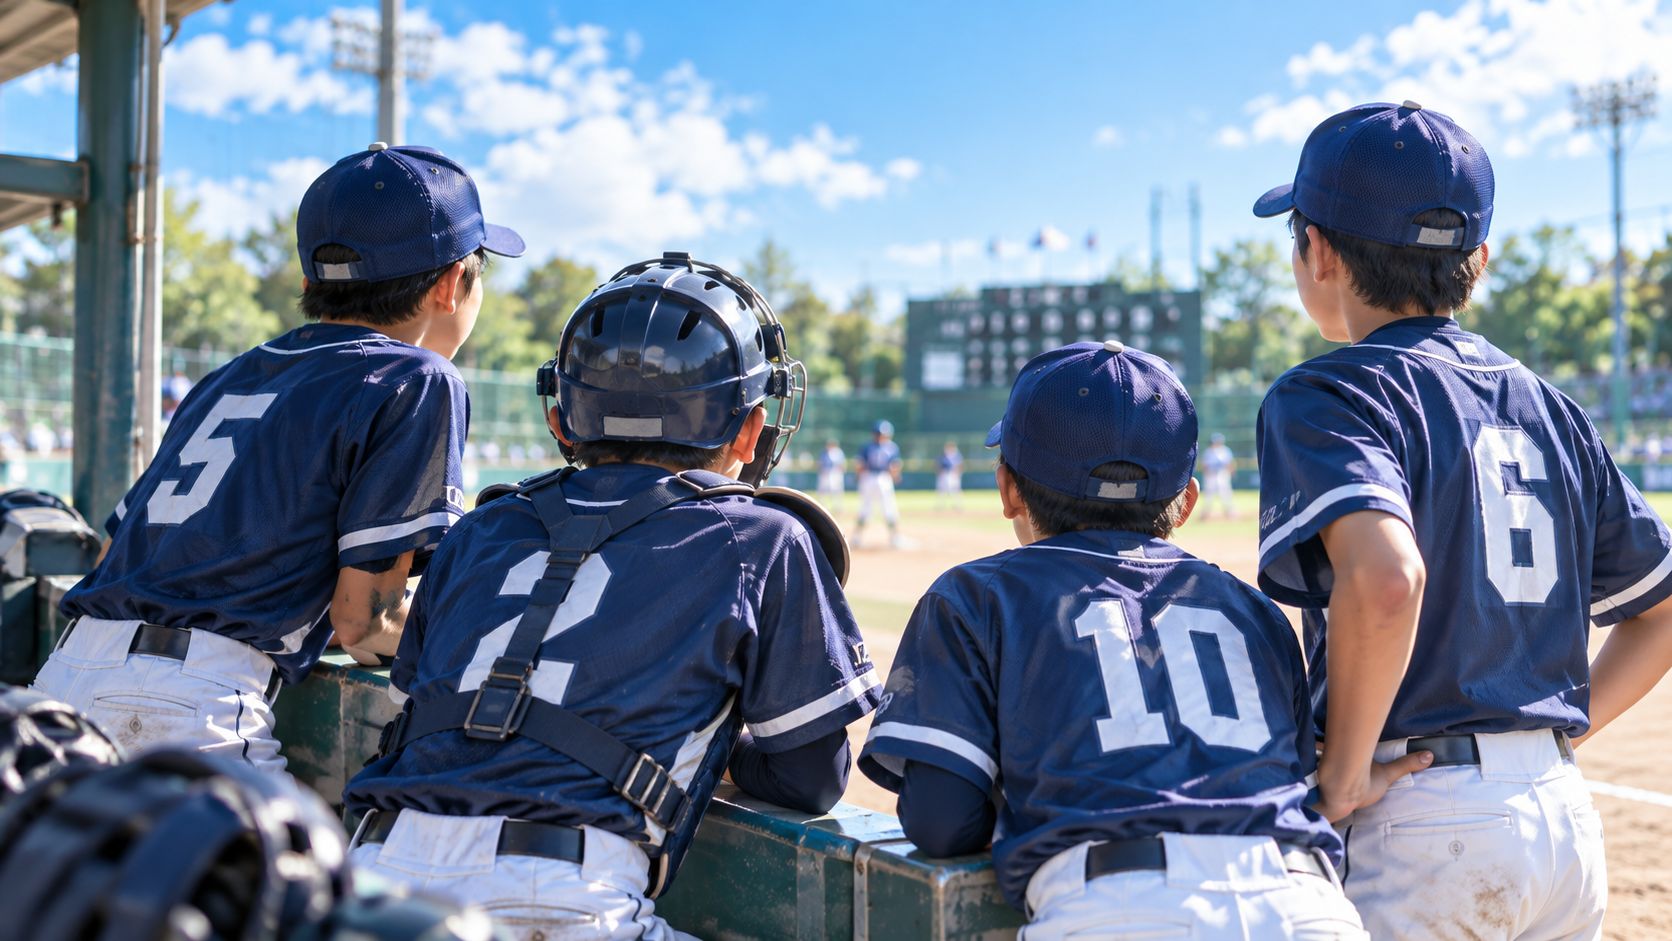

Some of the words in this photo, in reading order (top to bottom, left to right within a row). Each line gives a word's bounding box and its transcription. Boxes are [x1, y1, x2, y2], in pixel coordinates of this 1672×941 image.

[146, 393, 278, 524] 5
[1473, 425, 1559, 603] 6
[457, 550, 612, 705] 2
[1074, 600, 1272, 753] 10
